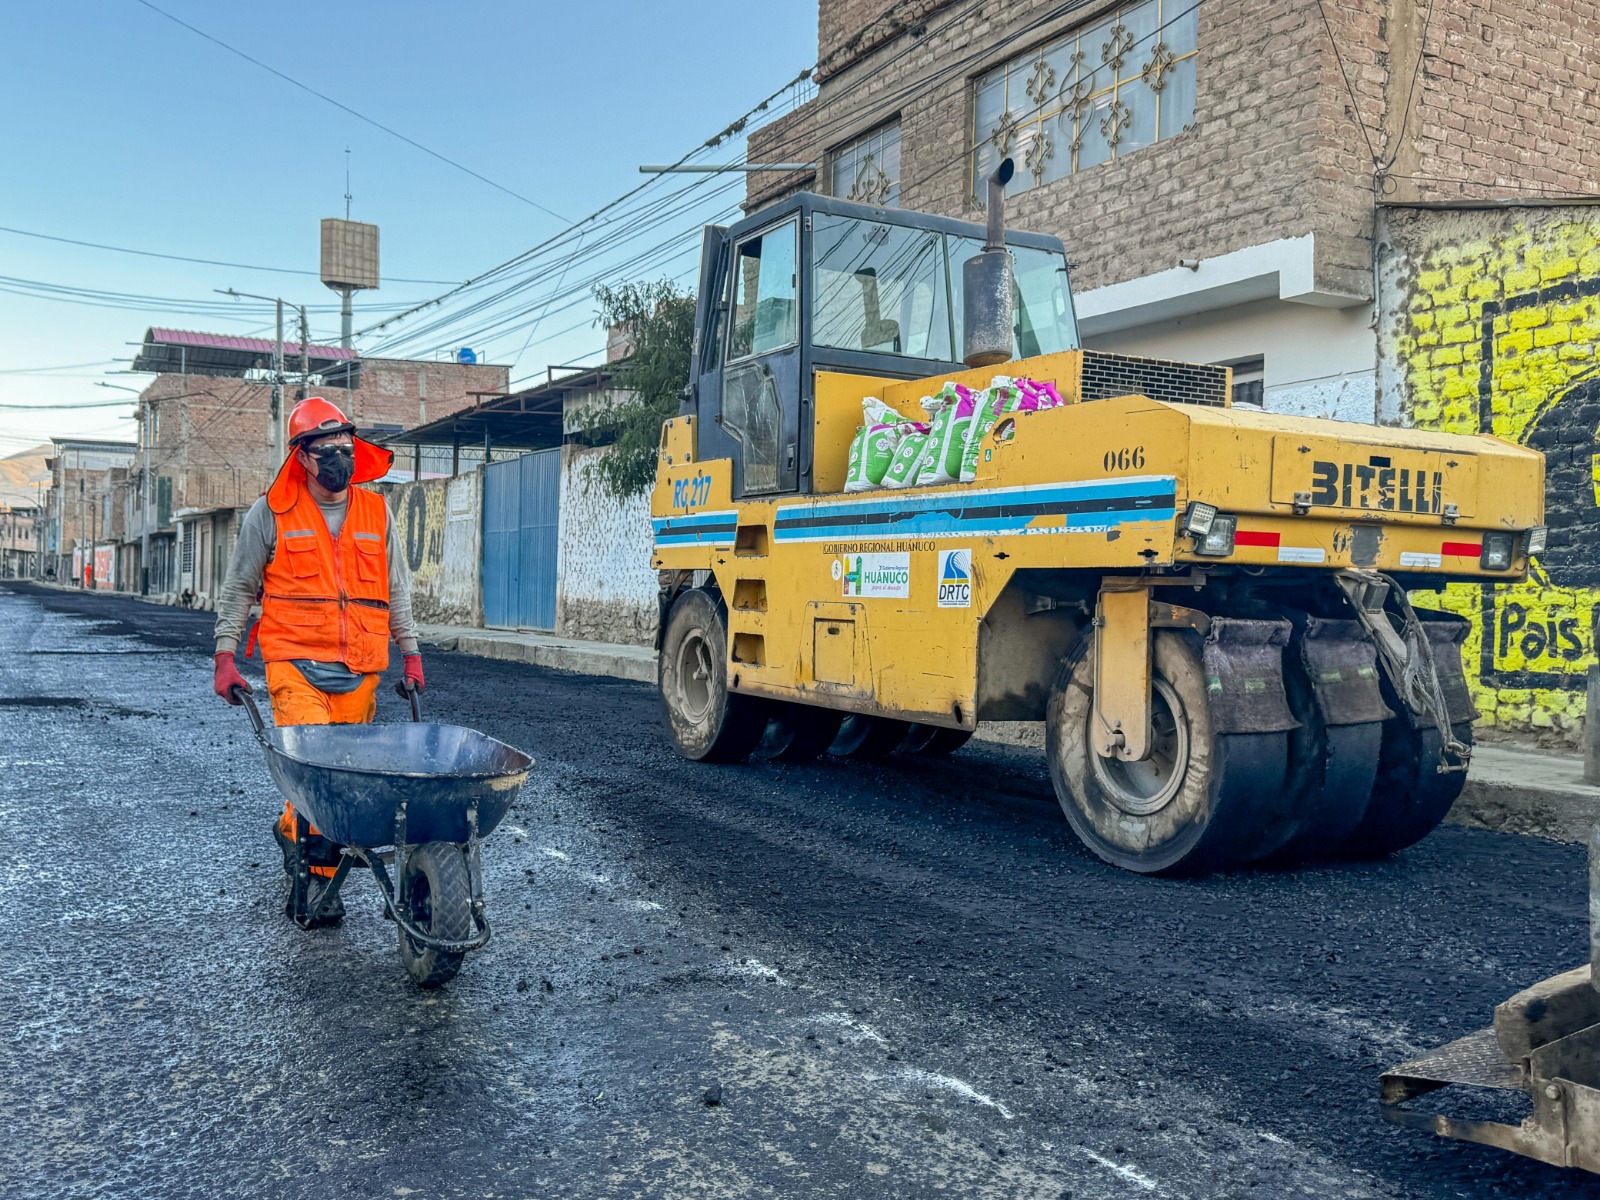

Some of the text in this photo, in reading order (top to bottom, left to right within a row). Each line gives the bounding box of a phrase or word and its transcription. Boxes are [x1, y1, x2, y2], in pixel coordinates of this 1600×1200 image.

[1104, 445, 1145, 472] 066
[690, 476, 711, 507] 217
[1312, 461, 1442, 514] BITELLI
[823, 539, 935, 553] GOBIERNO REGIONAL HUÁNUCO
[938, 583, 970, 600] DRTC
